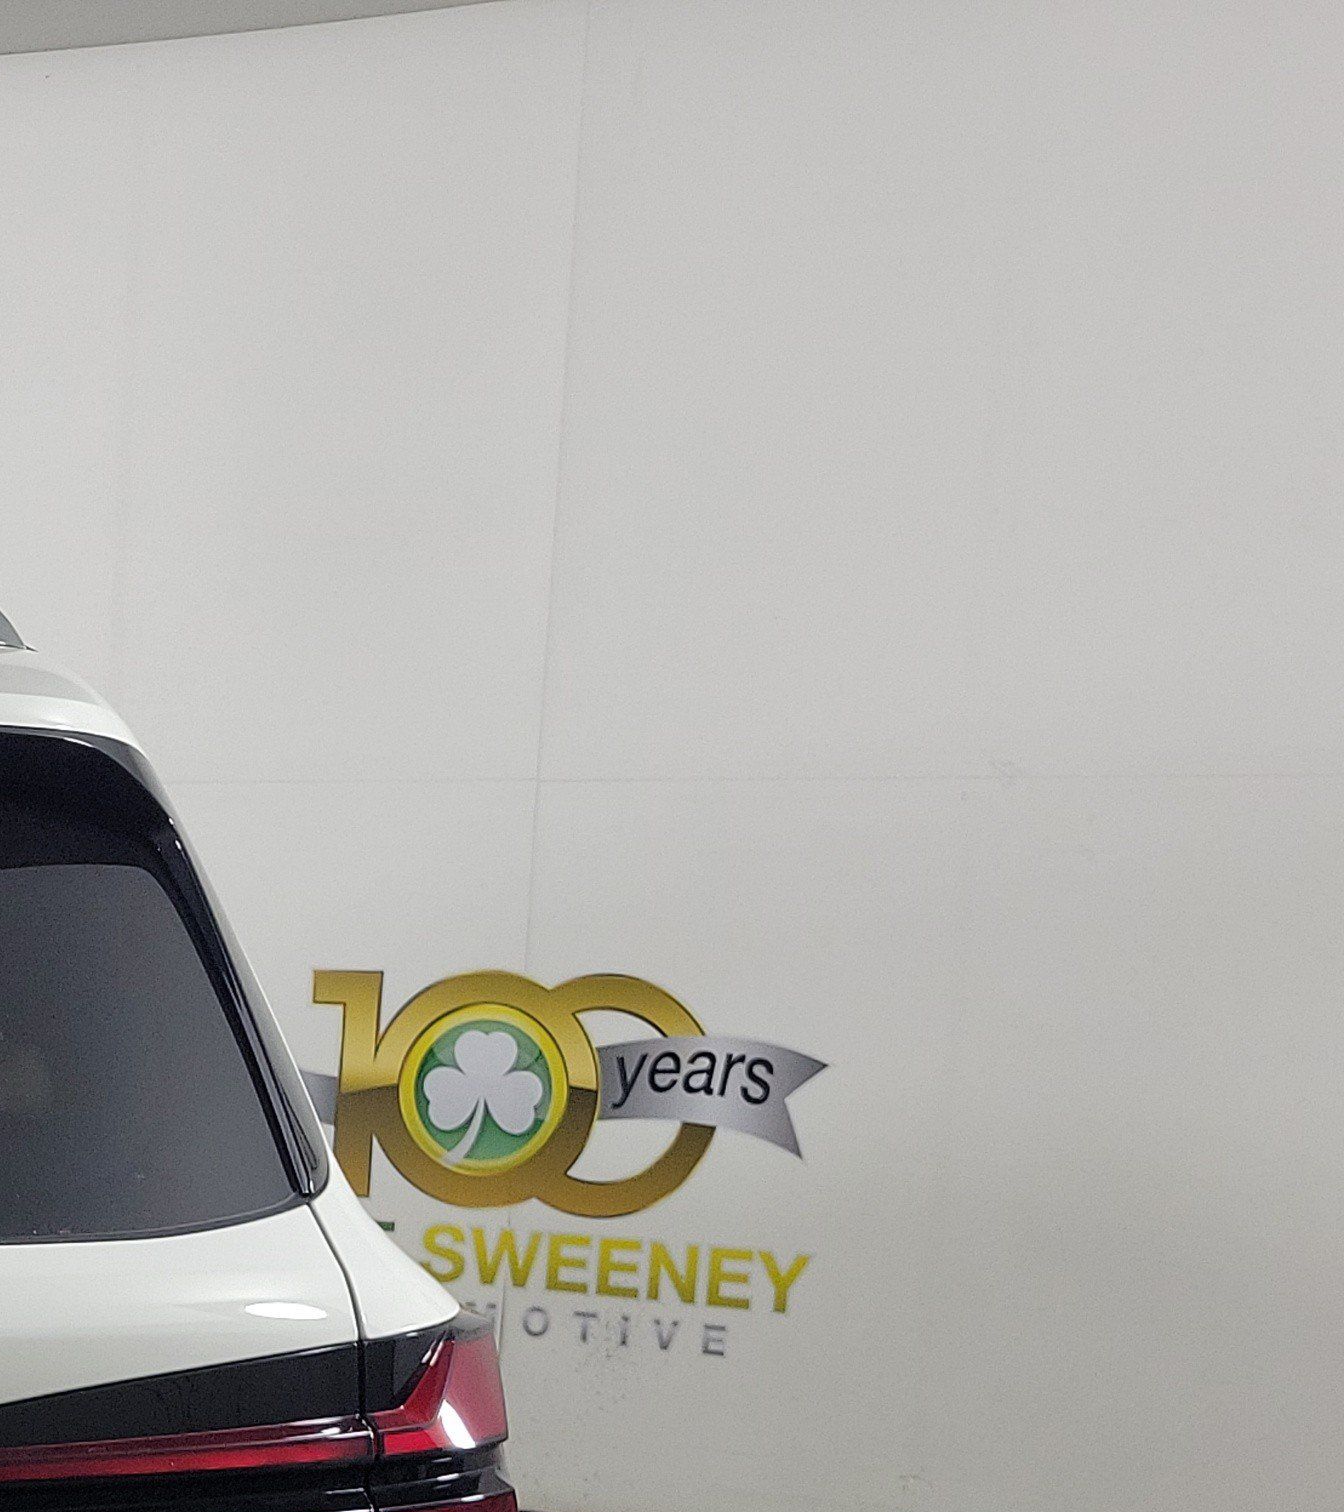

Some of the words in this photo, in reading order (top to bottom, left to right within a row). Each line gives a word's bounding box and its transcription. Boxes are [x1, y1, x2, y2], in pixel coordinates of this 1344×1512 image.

[612, 1050, 774, 1108] years
[420, 1223, 810, 1314] SWEENEY
[464, 1302, 727, 1357] OTIVE
